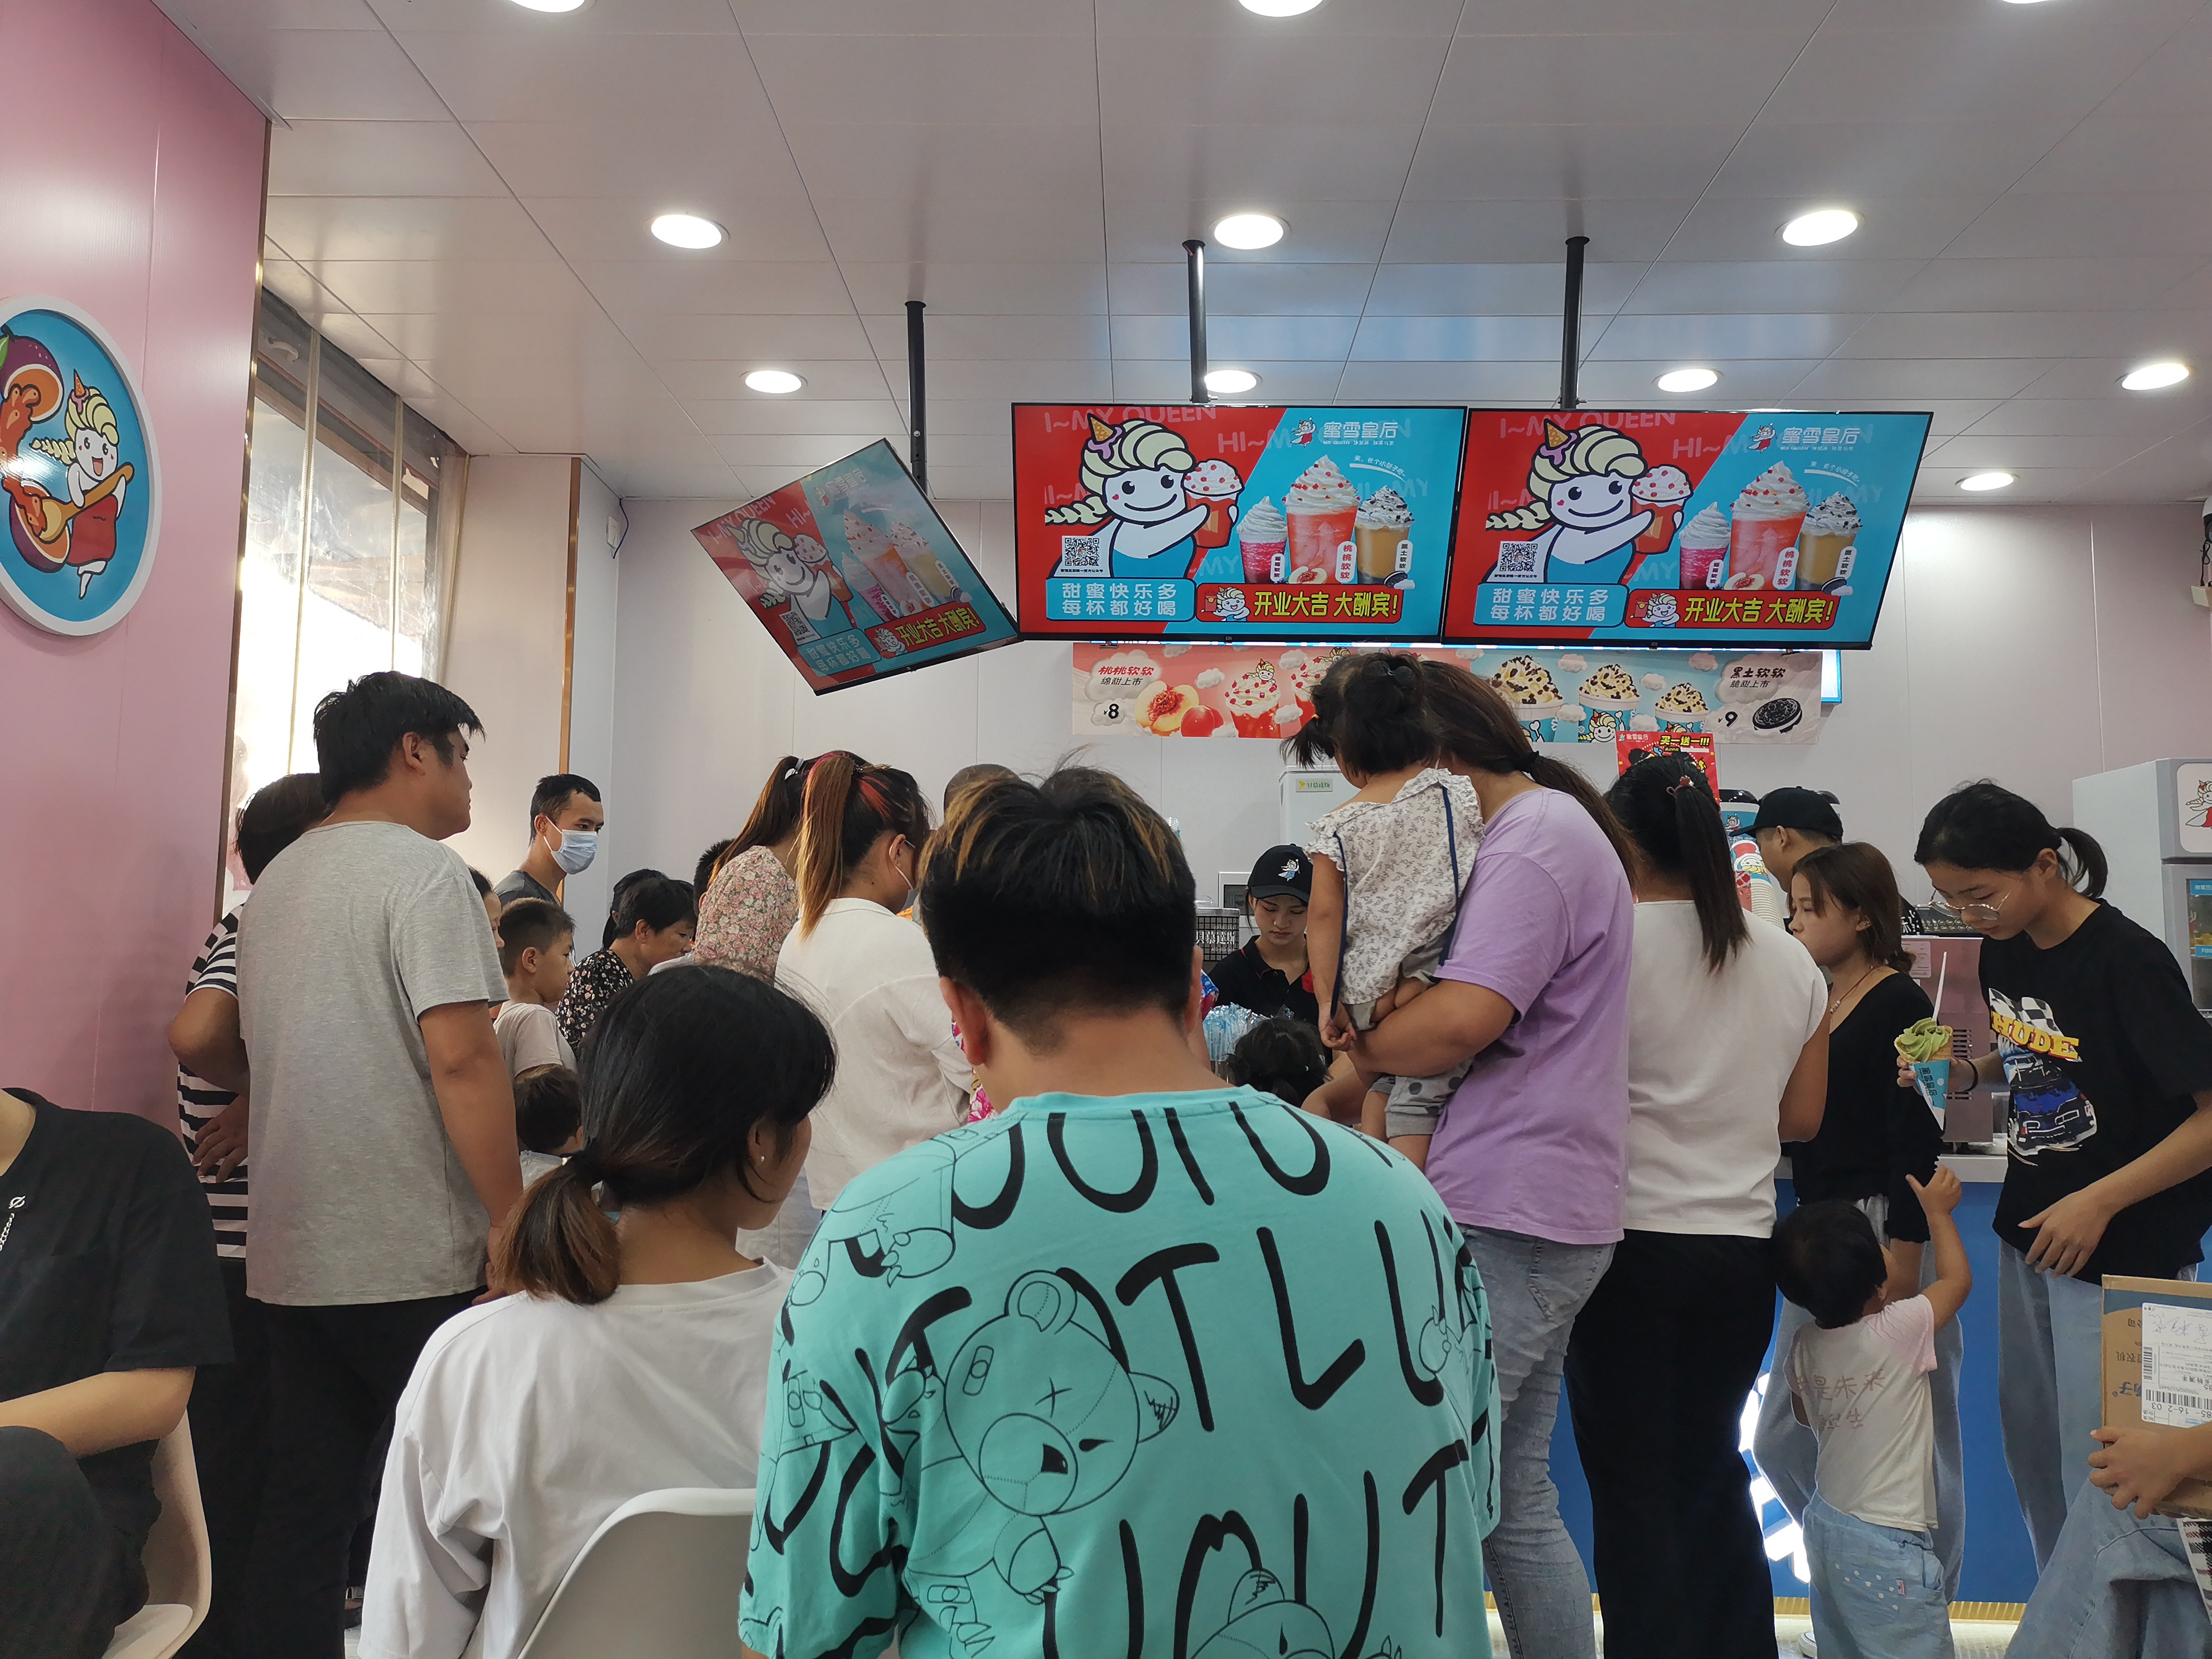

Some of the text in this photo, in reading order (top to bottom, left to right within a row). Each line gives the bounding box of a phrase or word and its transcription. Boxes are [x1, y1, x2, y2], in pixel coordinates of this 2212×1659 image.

[1323, 421, 1399, 439] 蜜雪皇后
[1782, 427, 1860, 444] 蜜雪皇后
[1062, 583, 1177, 600] 甜蜜快乐多
[1492, 588, 1608, 605] 甜蜜快乐多
[1062, 599, 1176, 616] 每杯都好喝
[1254, 591, 1398, 618] 开业大吉 大酬宾!
[1490, 604, 1606, 622] 每杯都好喝
[1684, 596, 1834, 624] 开业大吉 大酬宾!
[895, 617, 945, 647] 开业大吉
[1098, 666, 1154, 676] 桃桃软软
[1730, 666, 1786, 679] 黑土软软
[1100, 677, 1143, 686] 绵甜上市
[1729, 680, 1770, 688] 脆甜上市
[1660, 735, 1711, 746] 买一送一!!!
[1991, 1011, 2079, 1060] HUDE
